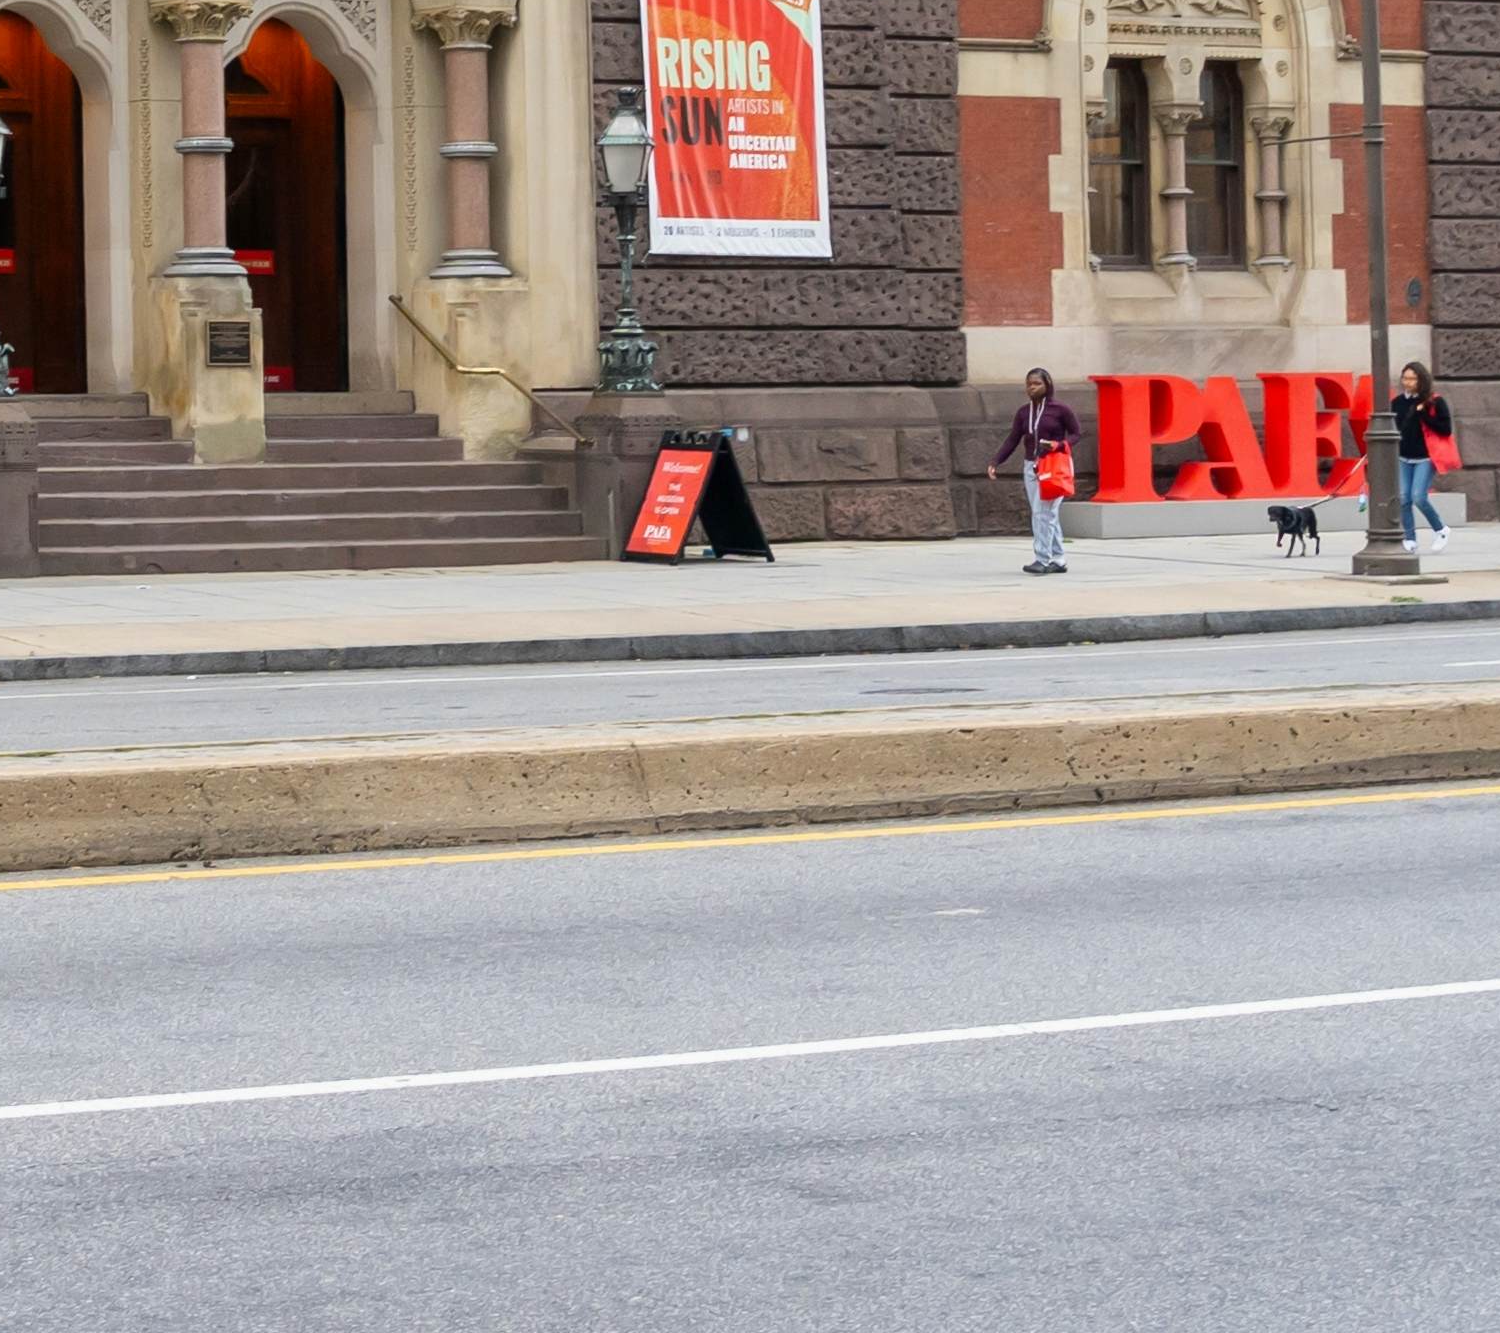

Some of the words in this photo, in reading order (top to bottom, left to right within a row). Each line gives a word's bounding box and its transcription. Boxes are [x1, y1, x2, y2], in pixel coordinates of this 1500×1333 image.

[656, 37, 771, 92] RISING
[727, 98, 769, 114] ARTISTS
[772, 100, 784, 115] IN
[660, 95, 725, 147] SUN
[728, 116, 745, 132] AN
[728, 135, 796, 152] UNCERTAIN
[729, 152, 788, 169] AMERICA
